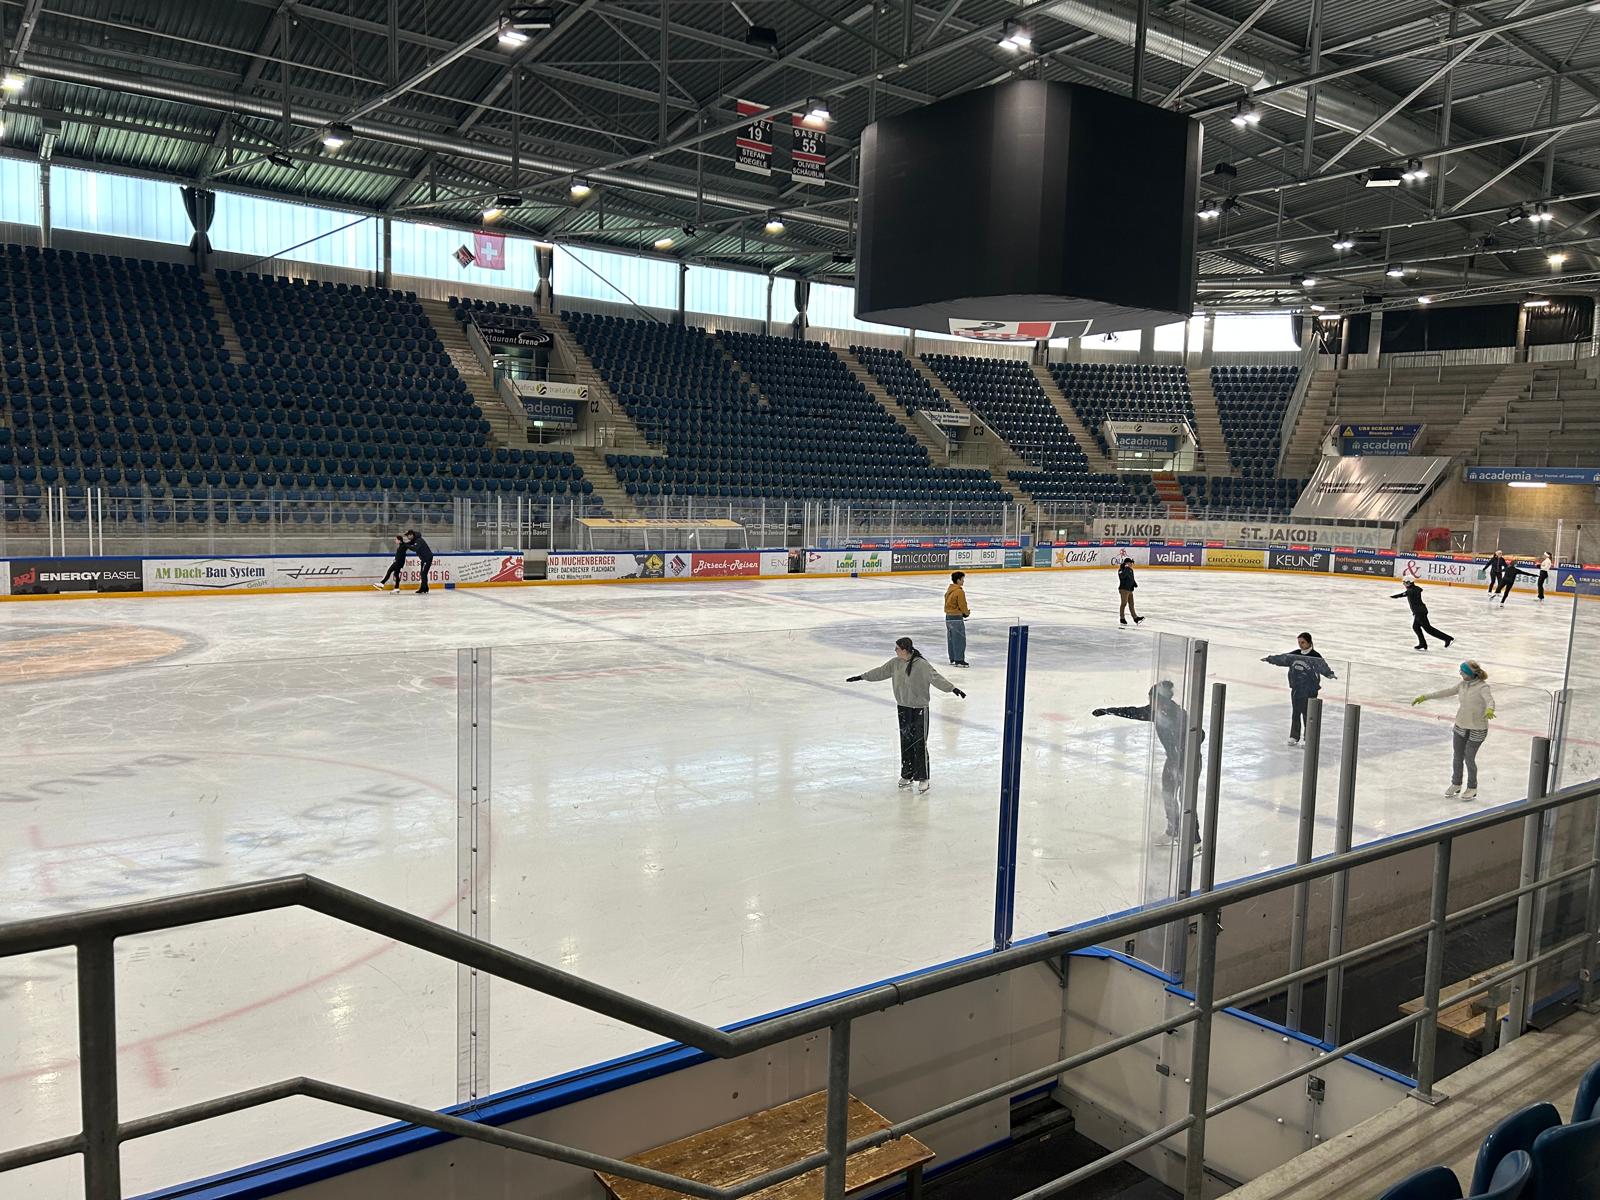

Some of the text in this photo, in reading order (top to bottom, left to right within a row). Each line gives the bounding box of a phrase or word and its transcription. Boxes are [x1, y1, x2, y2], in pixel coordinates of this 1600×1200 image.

[748, 126, 762, 141] 19
[794, 129, 825, 143] BASEL
[802, 138, 817, 153] 55
[742, 148, 766, 160] STEFAN
[739, 156, 768, 169] VOEGELE
[797, 160, 820, 172] OLIVIER
[518, 338, 539, 346] arena
[524, 400, 574, 415] ademia
[590, 400, 599, 413] C2
[973, 426, 984, 436] C3
[1119, 435, 1168, 446] academia
[1362, 440, 1411, 450] academi
[1479, 470, 1532, 481] academia
[901, 551, 947, 564] microtom
[1156, 551, 1194, 563] valiant
[1276, 554, 1320, 568] KEUNE
[693, 560, 759, 573] Birseck-Reisen
[836, 559, 858, 569] Landi
[862, 559, 883, 568] Landi
[1428, 563, 1466, 575] HB&P
[13, 568, 36, 586] NRJ
[40, 571, 140, 581] ENERGY BASEL
[155, 566, 266, 579] AM Dach-Bau System
[441, 570, 450, 580] 16
